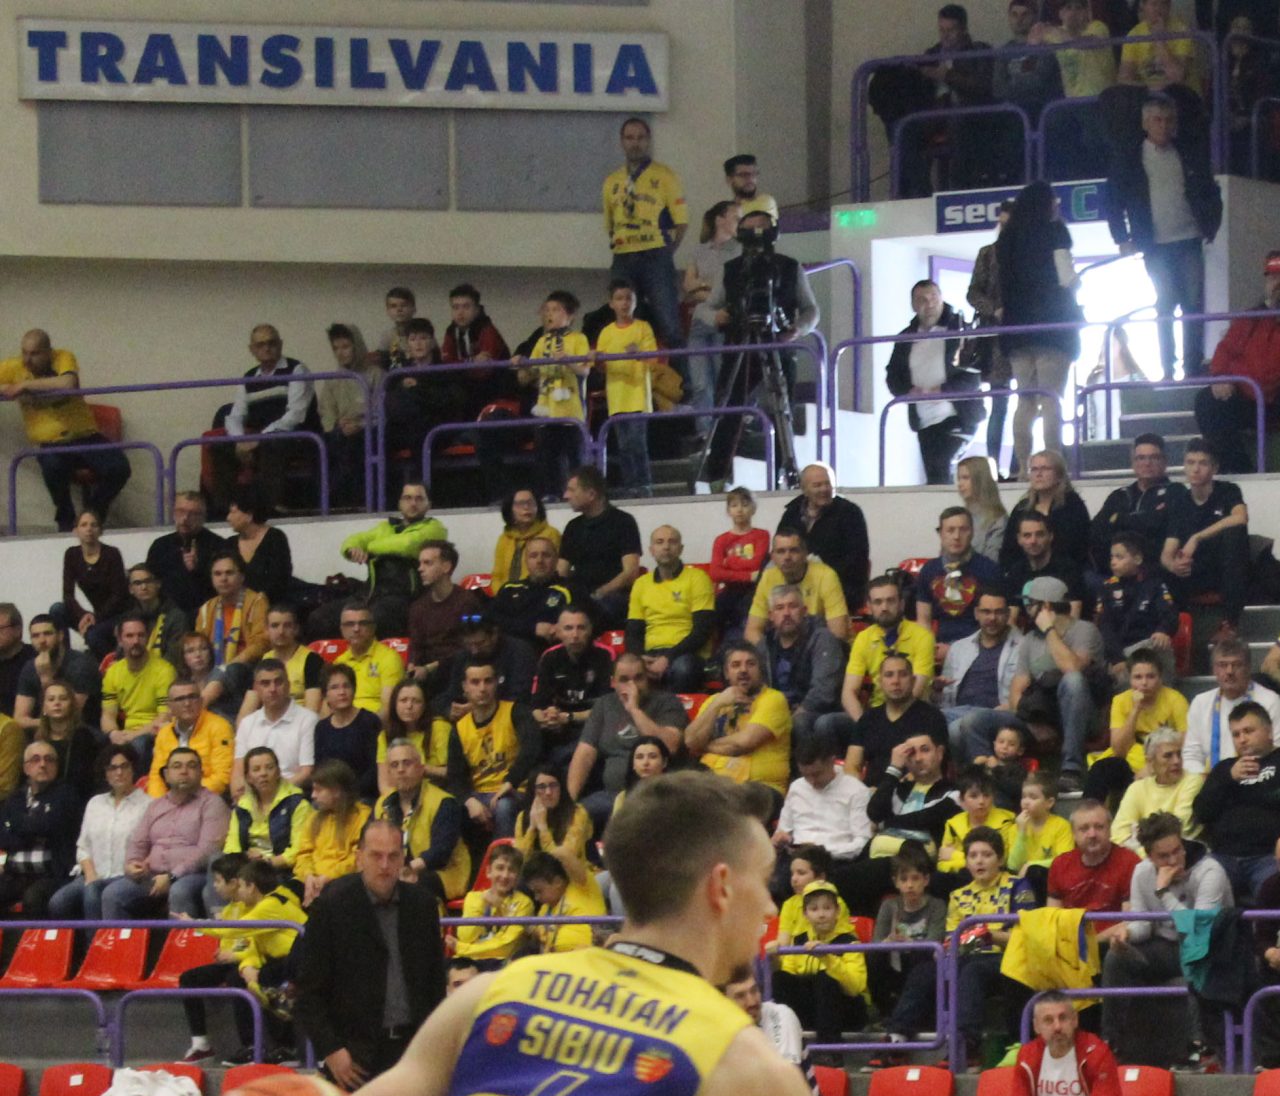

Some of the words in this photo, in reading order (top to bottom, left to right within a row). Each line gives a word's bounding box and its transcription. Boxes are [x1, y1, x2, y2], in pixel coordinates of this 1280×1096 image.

[27, 30, 658, 95] TRANSILVANIA
[1071, 185, 1099, 220] C
[518, 1014, 634, 1074] SIBIU
[1037, 1078, 1081, 1096] HUGO
